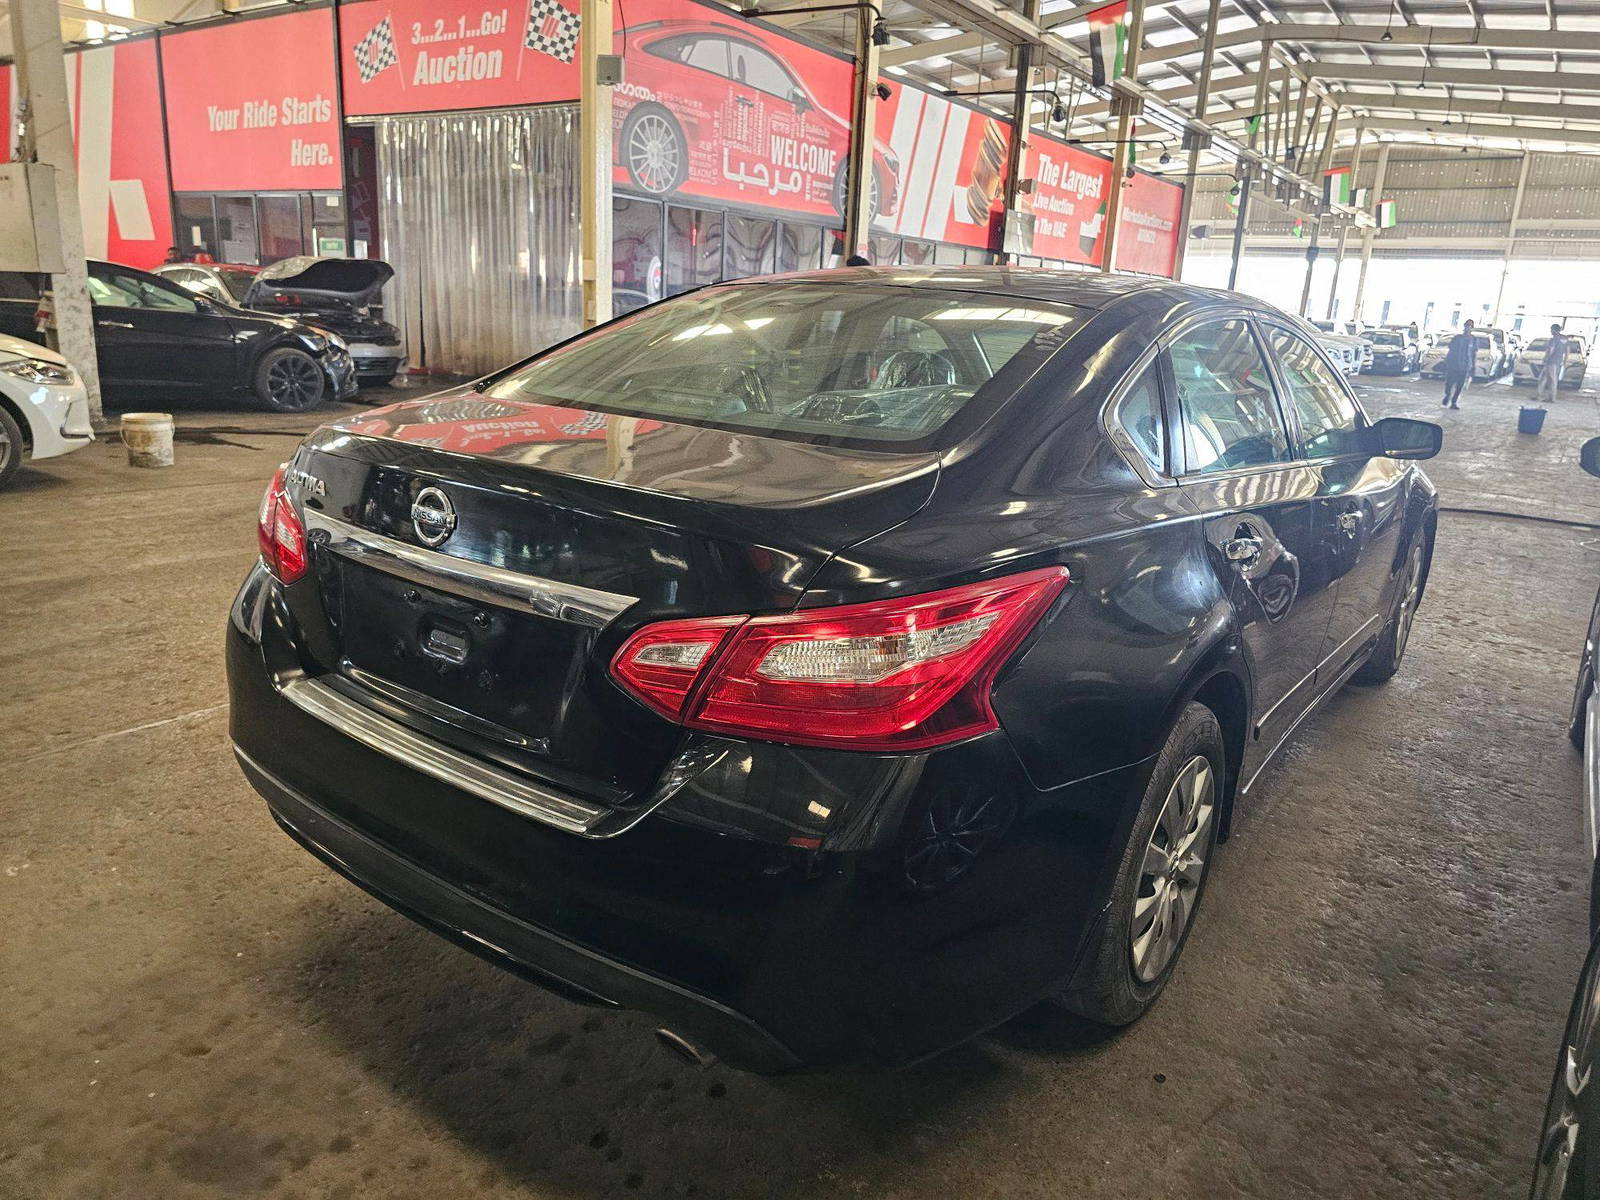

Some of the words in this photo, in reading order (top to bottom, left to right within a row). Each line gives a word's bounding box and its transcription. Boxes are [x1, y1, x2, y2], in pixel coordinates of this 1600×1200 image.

[412, 45, 503, 86] Auction
[207, 105, 240, 132] Your
[243, 99, 277, 129] Ride
[281, 94, 332, 126] Starts
[290, 138, 334, 167] Here.
[723, 147, 802, 196] مرحبا
[770, 134, 837, 178] WELCOME
[1037, 152, 1060, 188] The
[1060, 161, 1104, 200] Largest
[1033, 191, 1050, 211] Live
[1048, 194, 1075, 217] Auction
[1040, 217, 1053, 236] The
[413, 507, 449, 526] NISSAN
